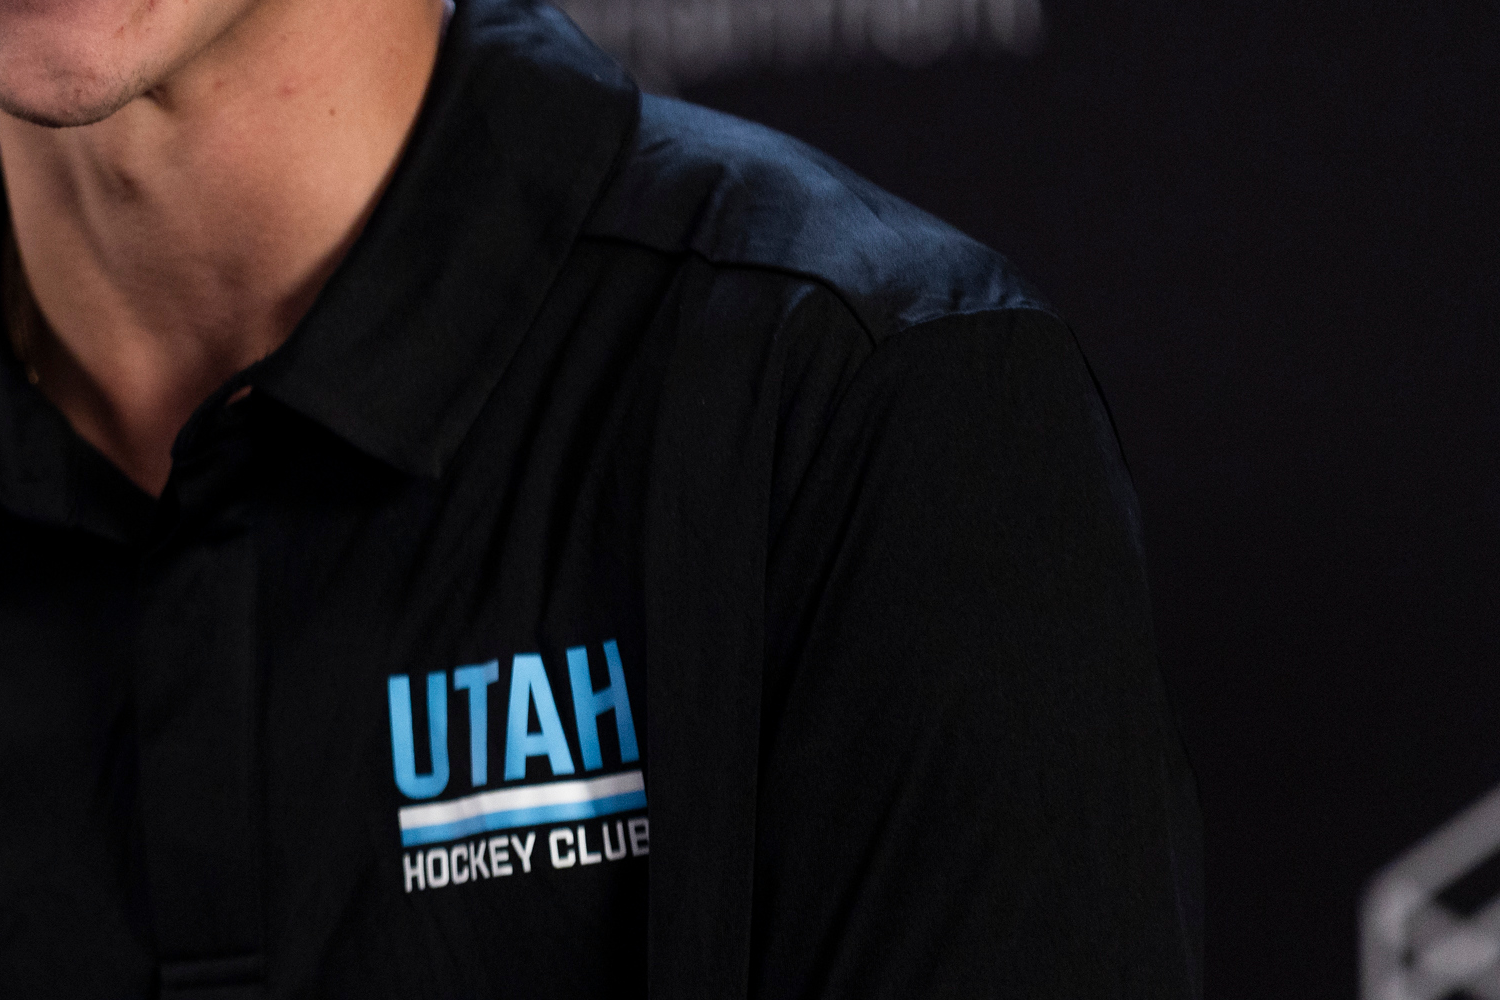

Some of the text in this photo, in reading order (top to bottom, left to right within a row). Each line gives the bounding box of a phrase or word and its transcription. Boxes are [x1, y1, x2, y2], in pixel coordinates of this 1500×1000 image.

[387, 638, 641, 800] UTAH
[402, 816, 650, 893] HOCKEY CLUB
